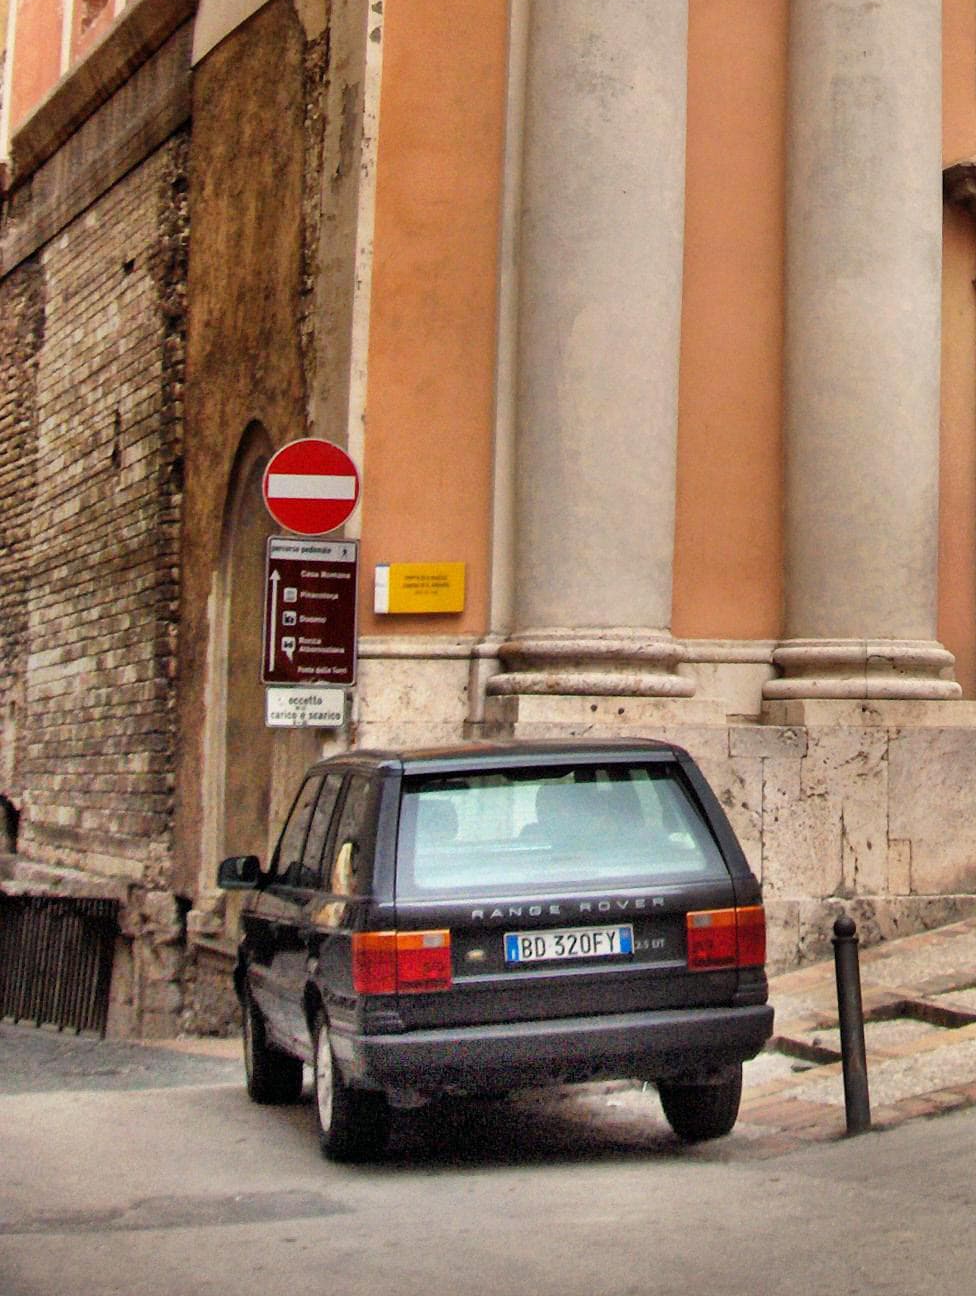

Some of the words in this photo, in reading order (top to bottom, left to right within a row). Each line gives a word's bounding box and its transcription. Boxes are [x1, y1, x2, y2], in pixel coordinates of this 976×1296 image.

[288, 695, 323, 705] eccetto
[270, 711, 297, 719] carico
[300, 712, 306, 720] e
[309, 712, 341, 720] scarico
[471, 905, 561, 920] RANGE
[579, 897, 665, 912] ROVER
[521, 935, 546, 958] BD
[554, 930, 616, 956] 320FY
